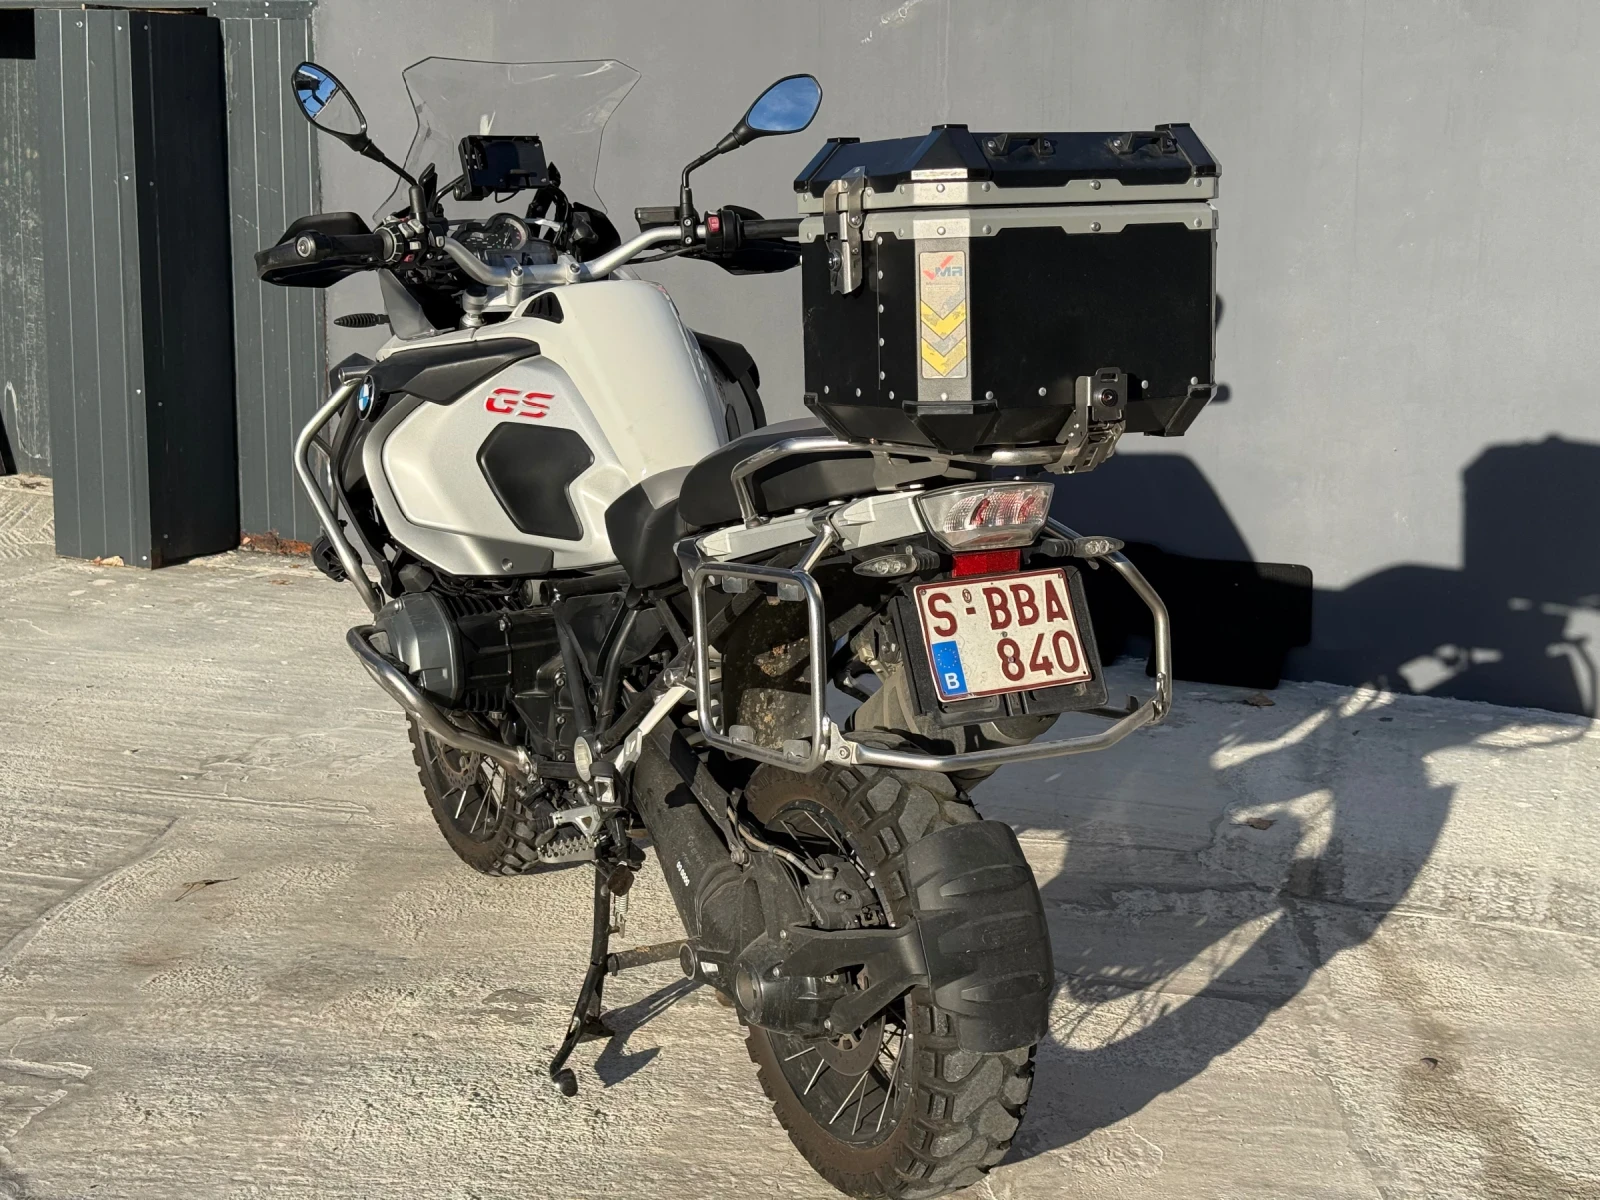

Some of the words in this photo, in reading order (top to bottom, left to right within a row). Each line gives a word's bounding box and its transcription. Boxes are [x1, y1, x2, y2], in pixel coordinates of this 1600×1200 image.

[485, 388, 555, 418] GS
[997, 630, 1080, 681] 840
[945, 672, 960, 689] B
